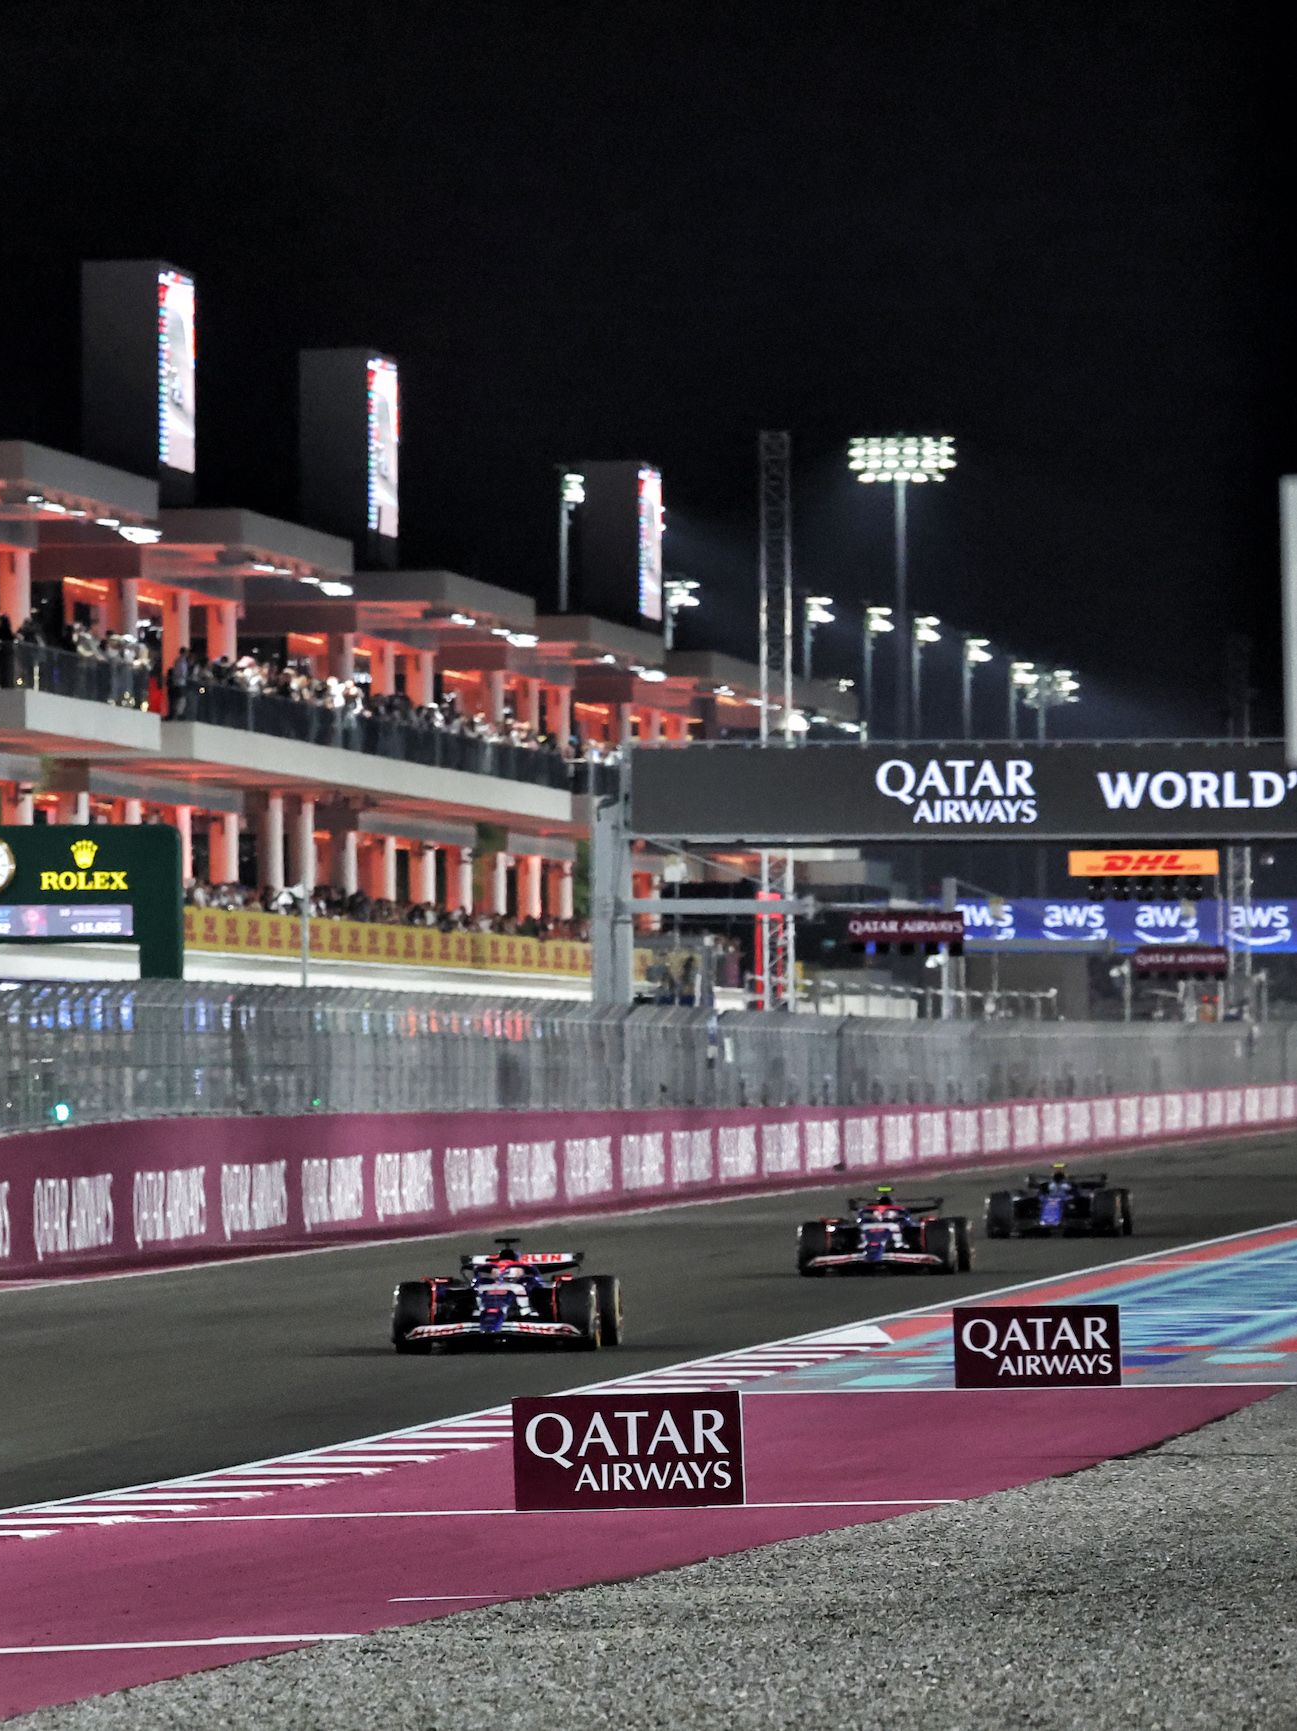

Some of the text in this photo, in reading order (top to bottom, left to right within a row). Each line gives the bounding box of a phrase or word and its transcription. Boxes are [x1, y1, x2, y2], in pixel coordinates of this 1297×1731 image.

[875, 759, 1036, 805] QATAR
[912, 798, 1038, 824] AIRWAYS
[1103, 855, 1185, 871] DHL
[40, 871, 128, 891] ROLEX
[1043, 904, 1105, 928] aws
[1230, 905, 1290, 928] aws
[848, 920, 899, 936] QATAR
[518, 1253, 562, 1265] RLEN
[962, 1317, 1111, 1360] QATAR
[998, 1354, 1113, 1376] AIRWAYS
[525, 1409, 730, 1469] QATAR
[574, 1461, 732, 1492] AIRWAYS
